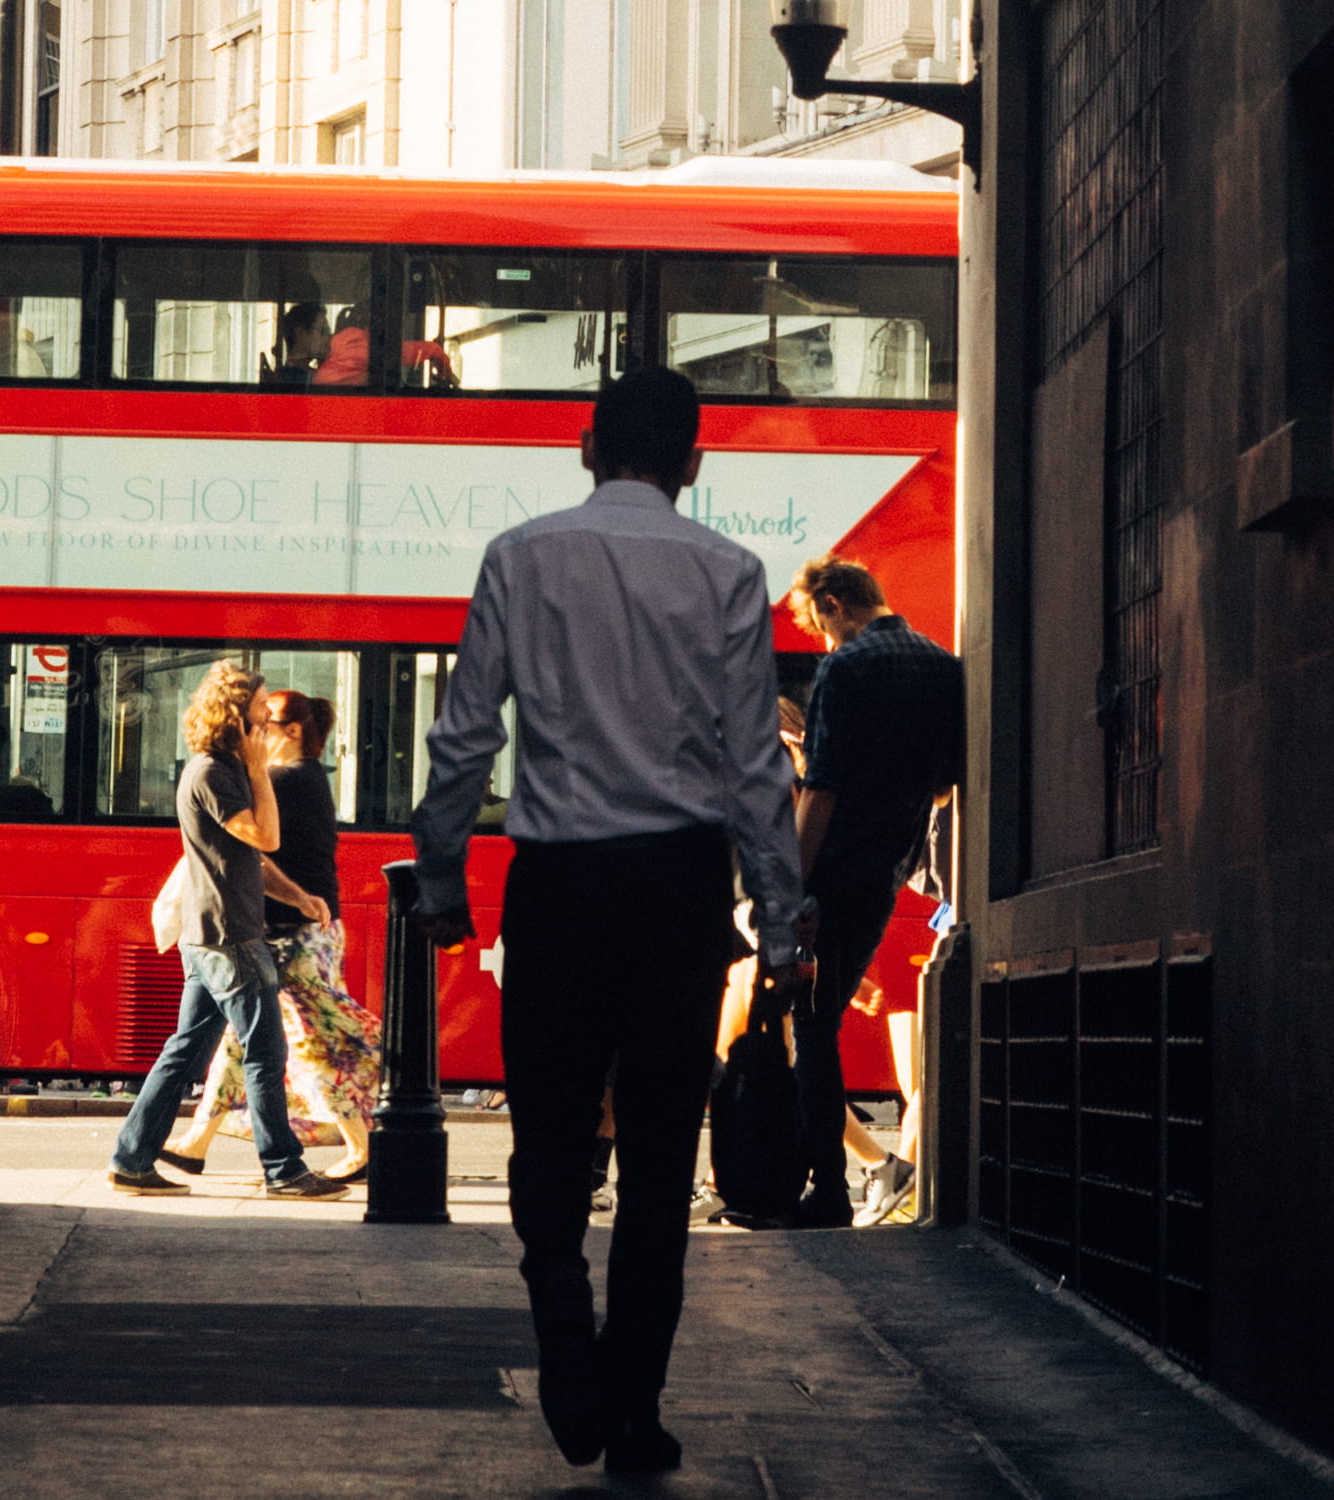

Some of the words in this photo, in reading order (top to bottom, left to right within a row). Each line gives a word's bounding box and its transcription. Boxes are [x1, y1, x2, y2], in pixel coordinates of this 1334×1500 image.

[120, 476, 282, 525] SHOE
[314, 480, 540, 533] HEAVEN
[690, 486, 808, 545] Harrods
[26, 530, 115, 549] FLOOR
[128, 533, 160, 550] OF
[174, 534, 266, 553] DIVINE
[278, 535, 452, 557] INSPIRATION
